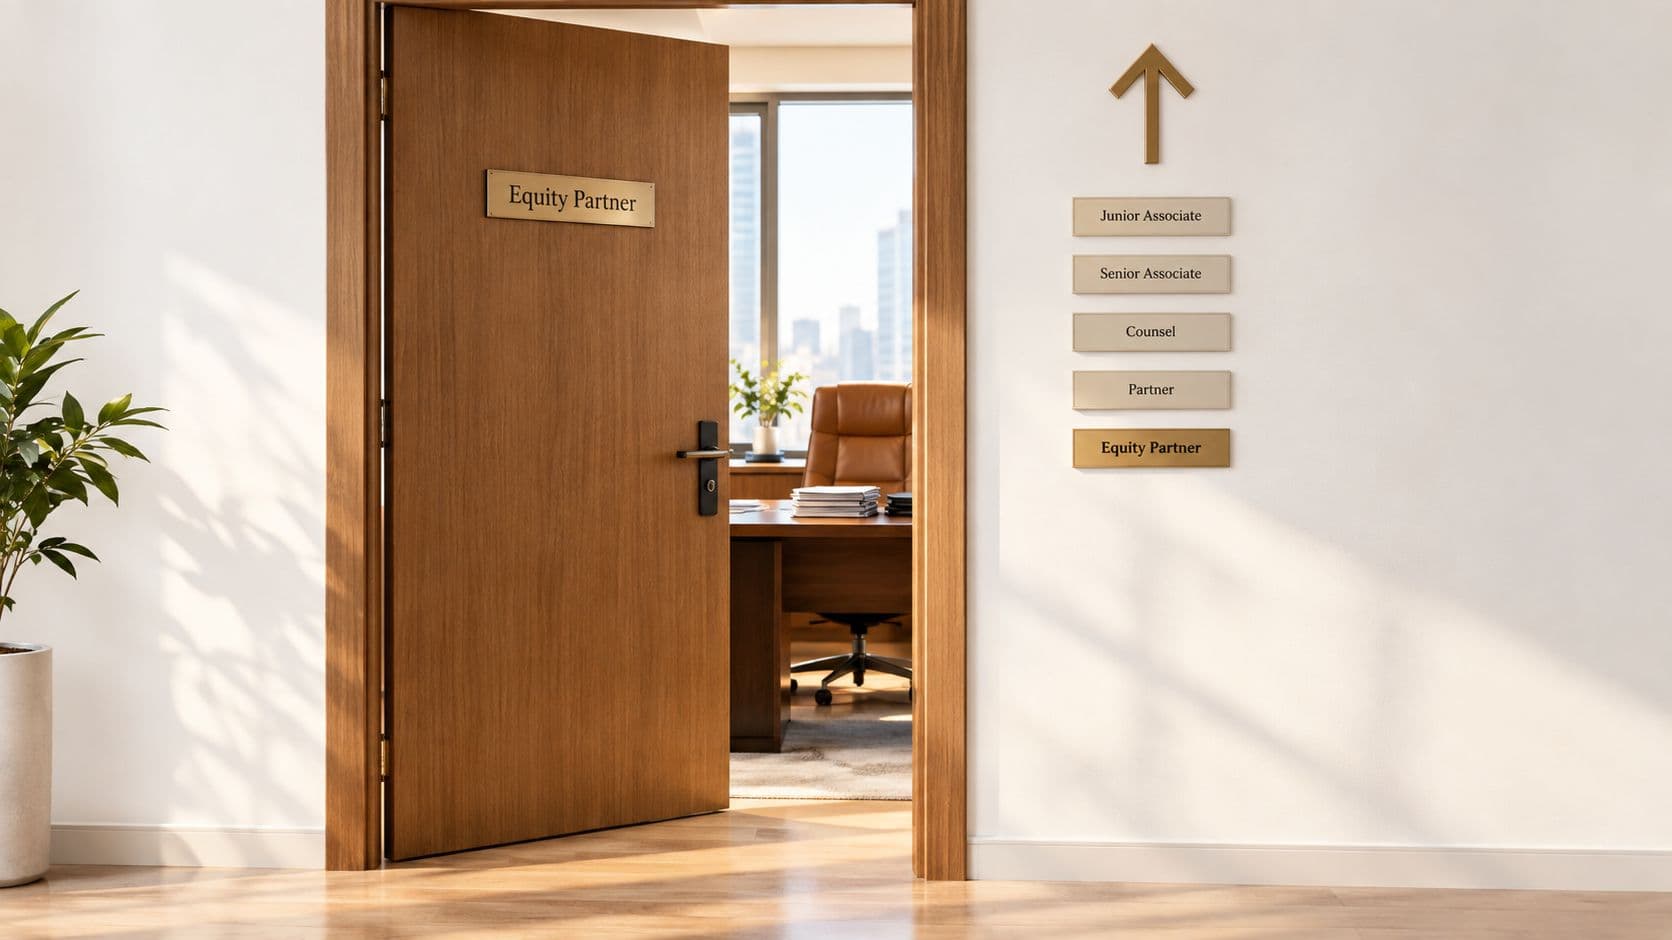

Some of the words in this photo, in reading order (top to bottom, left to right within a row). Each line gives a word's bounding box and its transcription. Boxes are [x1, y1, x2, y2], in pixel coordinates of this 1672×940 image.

[509, 184, 568, 212] Equity
[574, 189, 636, 212] Partner
[1100, 209, 1140, 222] Junior
[1143, 209, 1202, 222] Associate
[1100, 267, 1140, 280] Senior
[1143, 267, 1202, 280] Associate
[1126, 325, 1176, 338] Counsel
[1128, 383, 1175, 396] Partner
[1101, 441, 1145, 458] Equity
[1150, 441, 1202, 454] Partner
